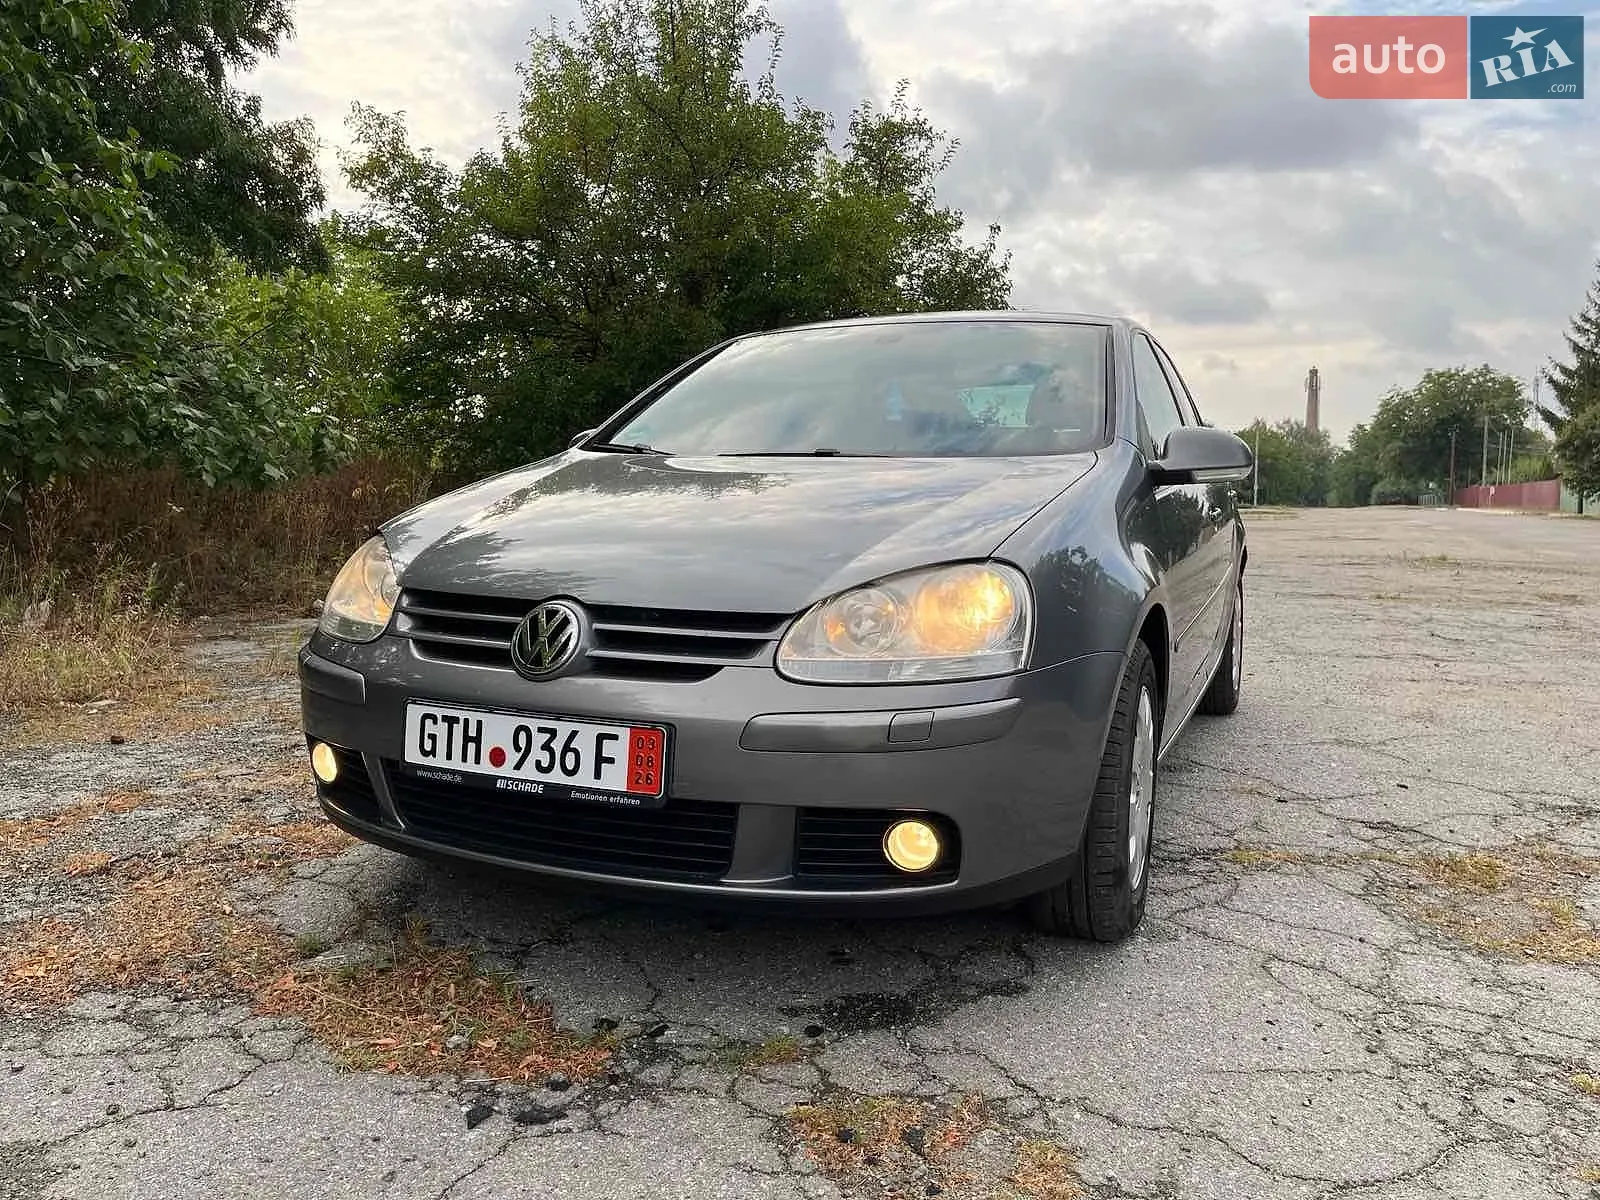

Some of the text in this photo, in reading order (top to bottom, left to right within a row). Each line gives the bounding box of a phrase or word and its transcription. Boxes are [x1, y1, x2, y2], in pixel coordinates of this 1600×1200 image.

[418, 712, 619, 781] GTH 936 F
[636, 736, 656, 750] 03
[636, 754, 655, 769] 08
[416, 768, 463, 783] www.schade.de
[634, 771, 654, 786] 26
[570, 791, 640, 806] Emotionen erfahren
